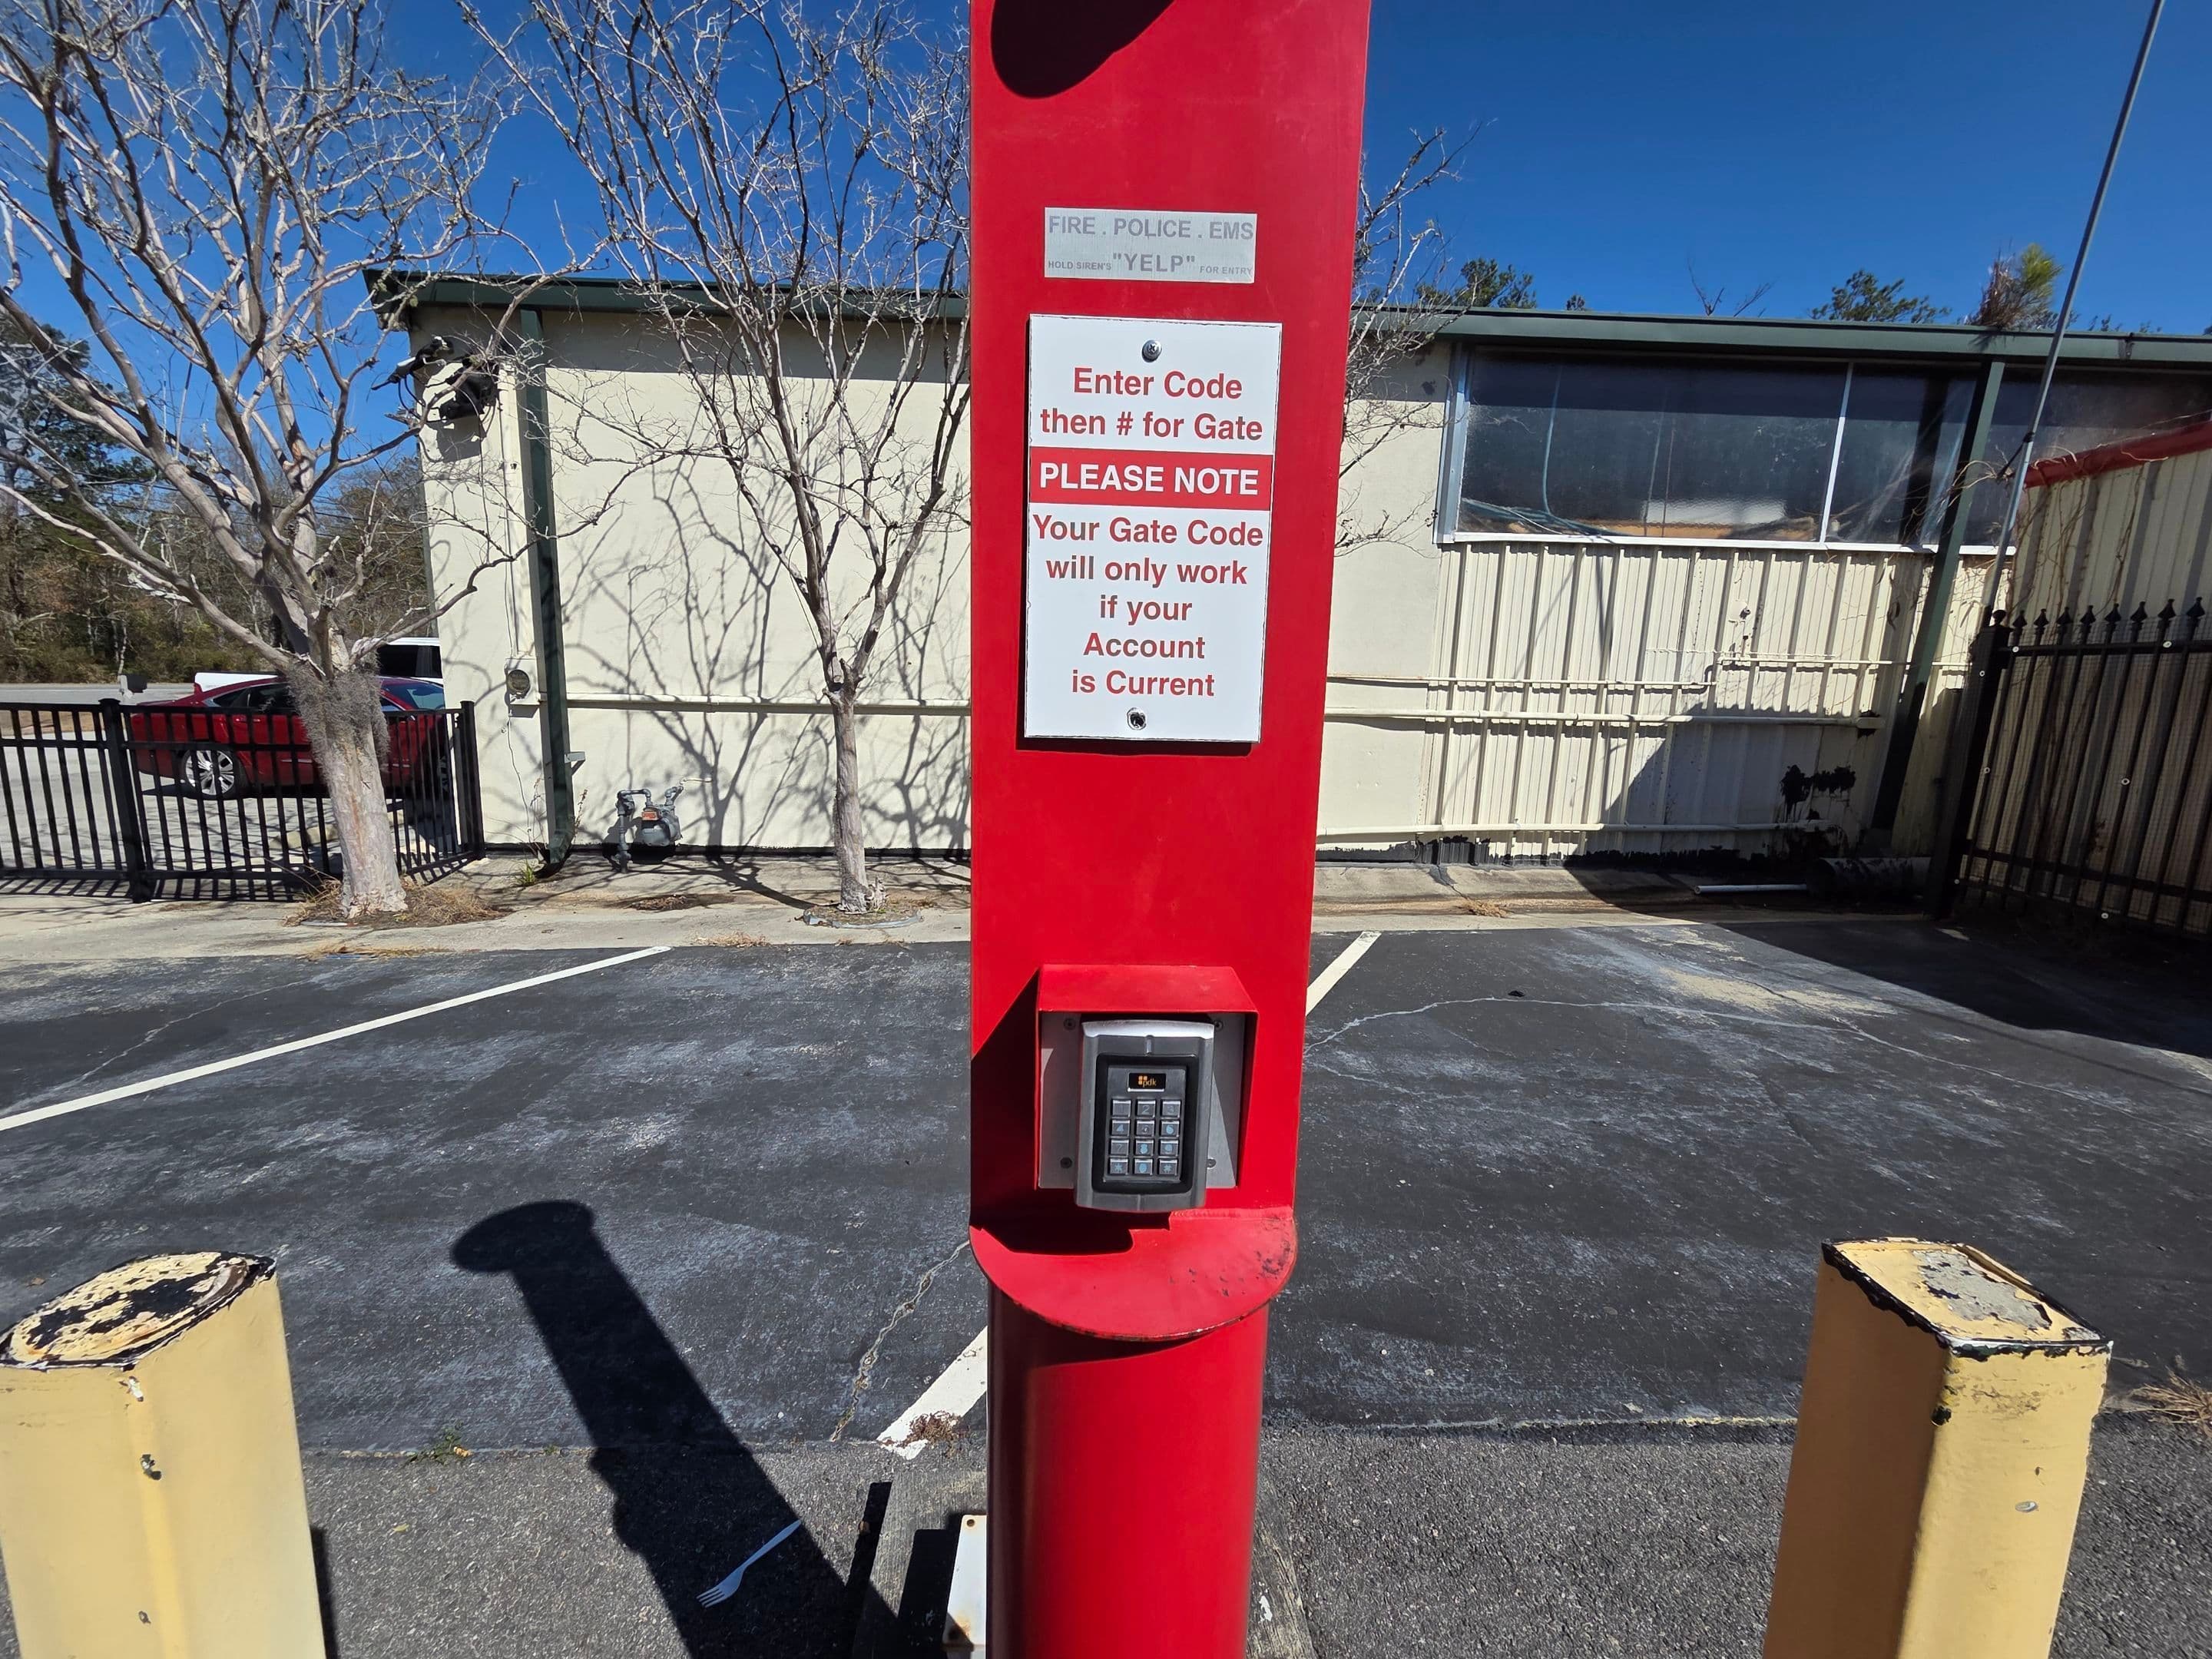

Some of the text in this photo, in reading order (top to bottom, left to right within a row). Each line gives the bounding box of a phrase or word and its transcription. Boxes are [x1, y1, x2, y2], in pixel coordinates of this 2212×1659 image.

[1048, 215, 1096, 235] FIRE
[1113, 217, 1191, 239] POLICE
[1209, 221, 1253, 240] EMS
[1048, 252, 1252, 275] HOLD SIREN'S "YELP" FOR ENTRY
[1074, 367, 1243, 399] Enter Code
[1040, 407, 1263, 440] then # for Gate
[1040, 462, 1259, 495] PLEASE NOTE
[1032, 514, 1263, 546] Your Gate Code
[1046, 555, 1248, 588] will only work
[1100, 594, 1193, 626] if your
[1083, 632, 1206, 659] Account
[1072, 669, 1215, 697] is Current
[1140, 1144, 1148, 1154] 8
